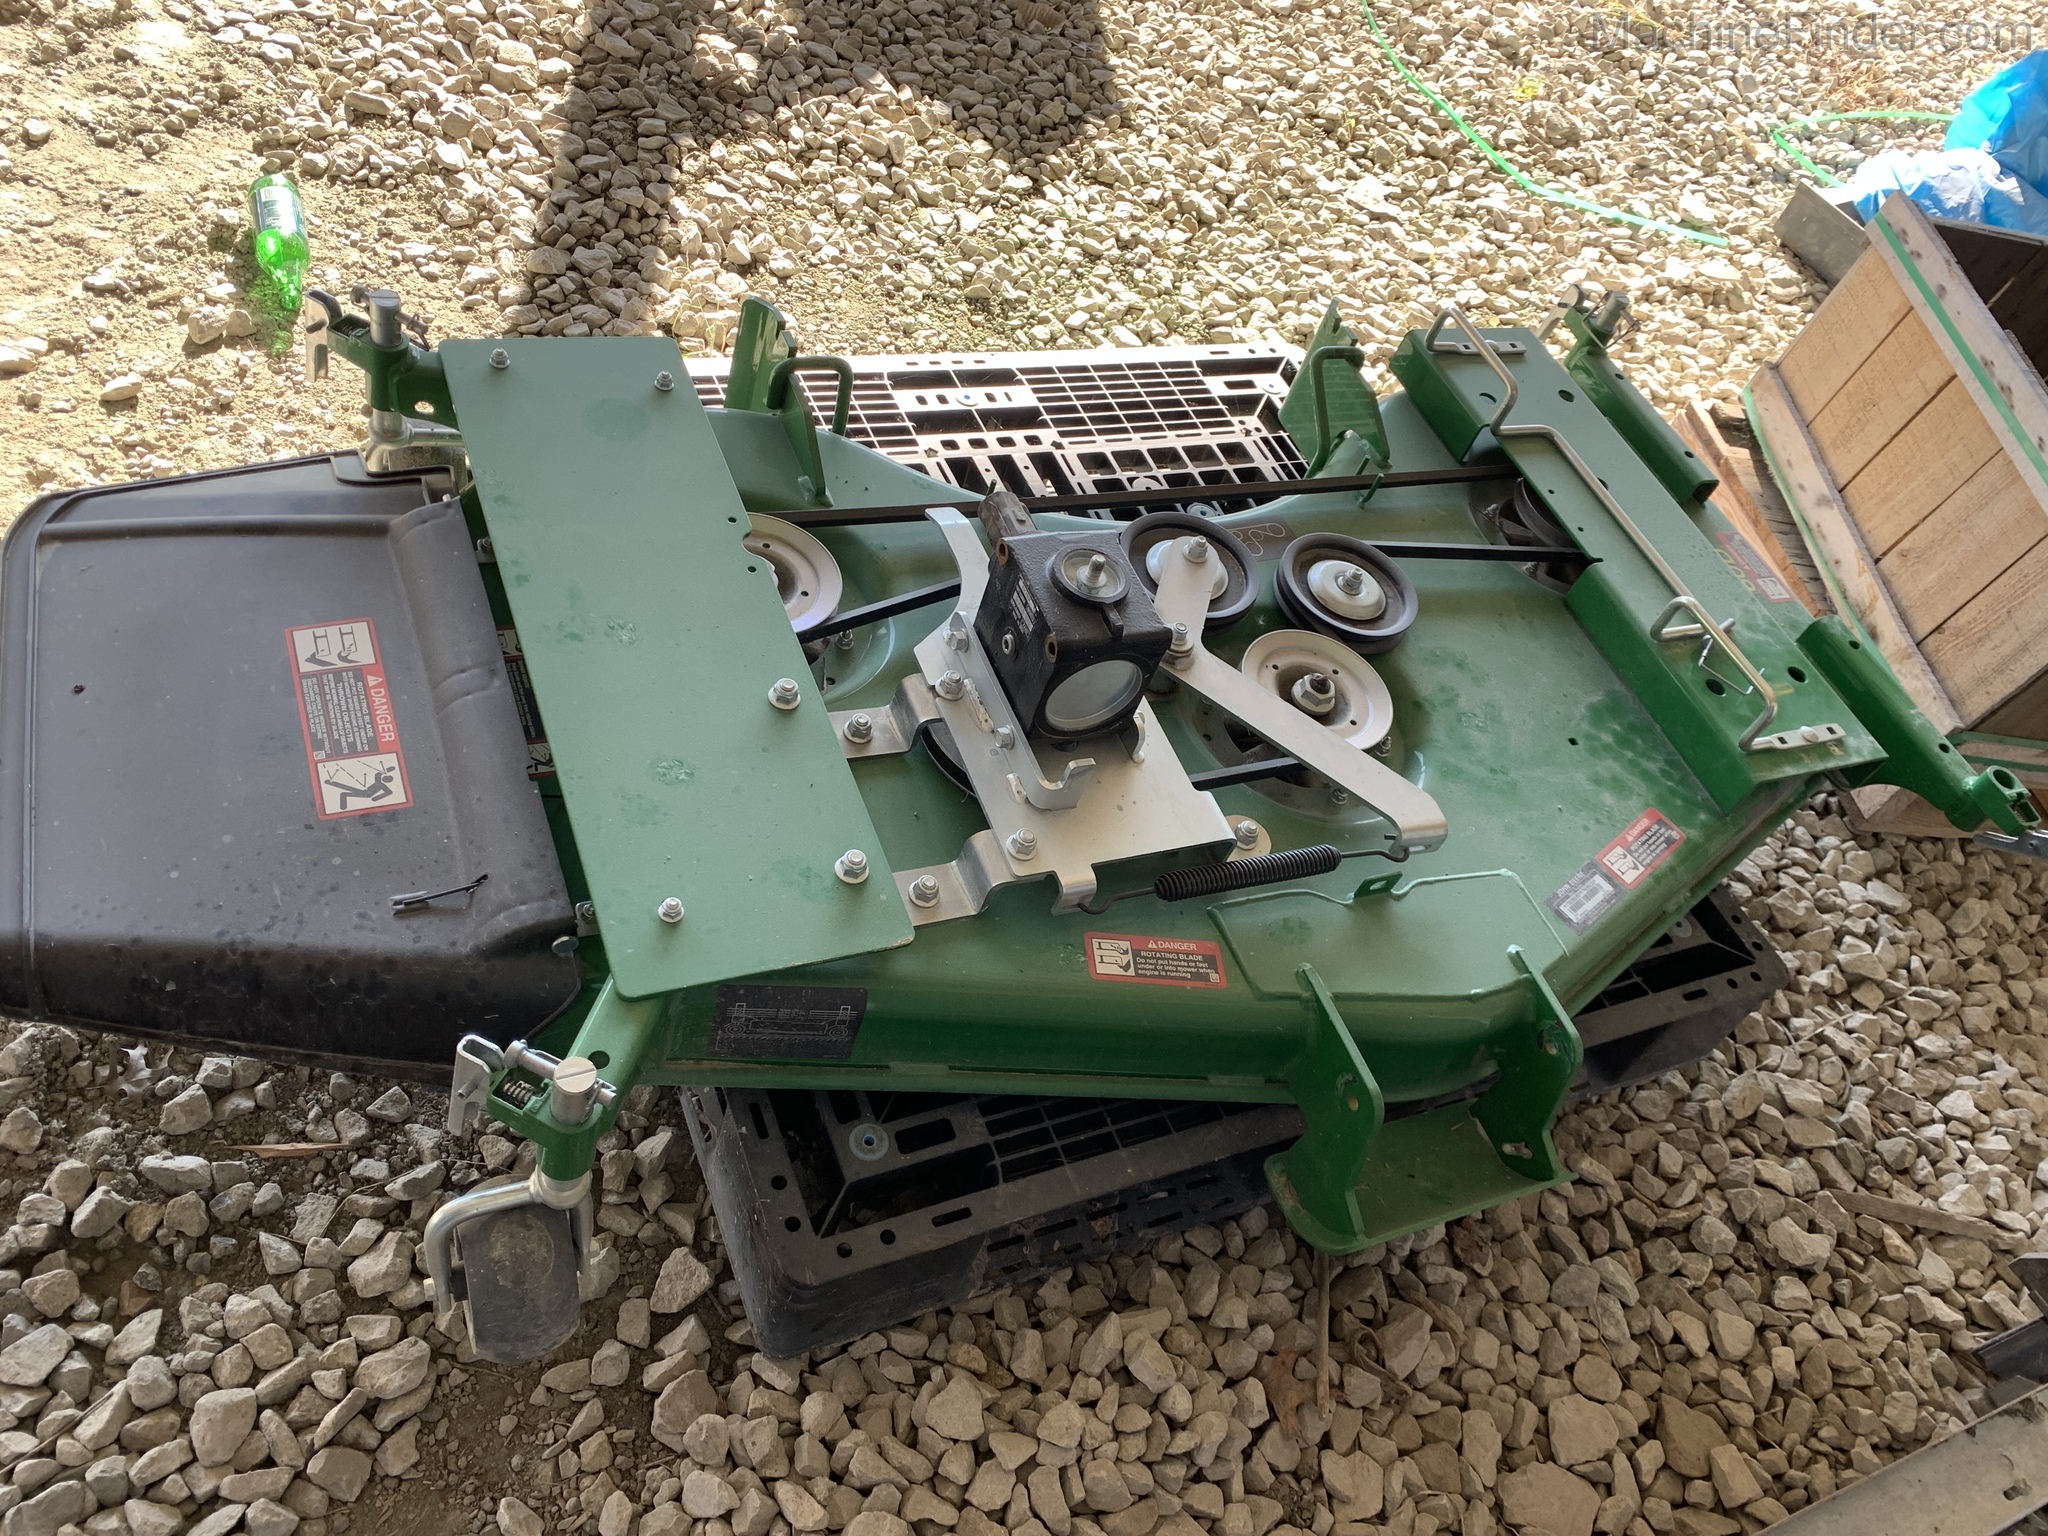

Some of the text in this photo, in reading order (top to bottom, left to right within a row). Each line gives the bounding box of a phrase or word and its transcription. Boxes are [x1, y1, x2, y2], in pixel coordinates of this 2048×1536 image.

[306, 678, 315, 701] DISCHARGE
[304, 693, 312, 713] CATCHER
[327, 673, 335, 688] BEFORE
[340, 735, 348, 753] OBJECTS
[336, 682, 353, 742] THROWN OBJECTS
[356, 681, 373, 737] ROTATING BLADE
[370, 687, 395, 741] DANGER
[314, 694, 323, 714] OPERATE
[322, 733, 330, 753] WITHOUT
[343, 681, 351, 697] MOWER
[349, 710, 357, 726] ENGINE
[353, 731, 362, 751] RUNNING
[359, 728, 367, 743] UNDER
[1629, 818, 1650, 838] DANGER
[1555, 882, 1570, 897] JOHN
[1568, 870, 1585, 886] DEERE
[1140, 950, 1177, 959] ROTATING
[1157, 941, 1196, 950] DANGER
[1137, 968, 1159, 976] engine
[1166, 970, 1191, 978] running
